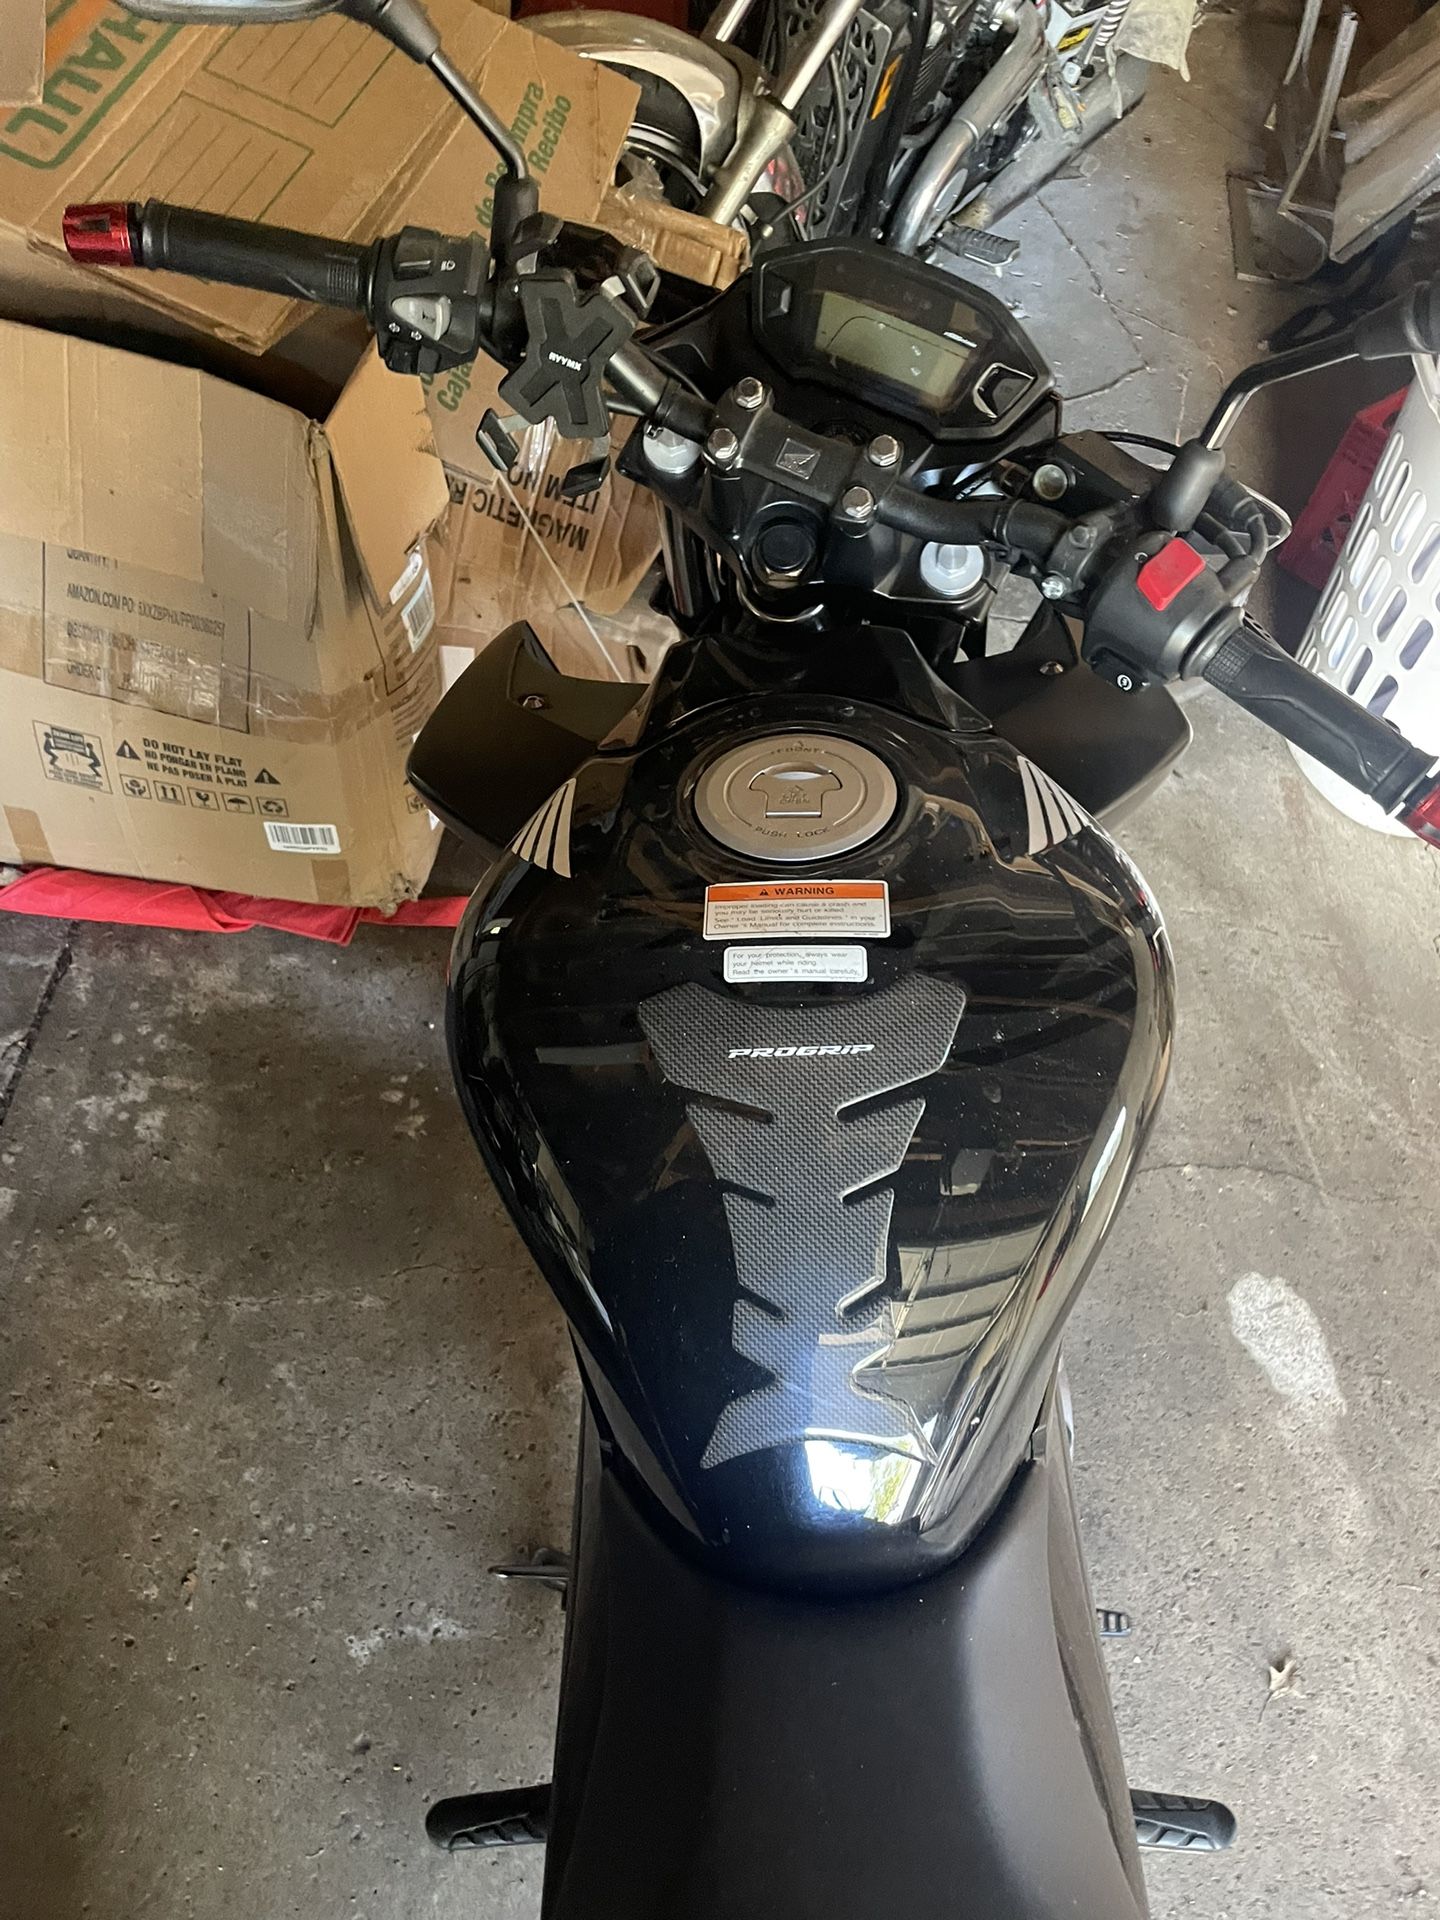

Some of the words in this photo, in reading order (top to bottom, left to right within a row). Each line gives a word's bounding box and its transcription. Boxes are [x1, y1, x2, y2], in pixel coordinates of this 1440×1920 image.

[527, 95, 572, 173] Recibo
[472, 488, 590, 551] MAGNETIC
[142, 737, 159, 749] DO
[162, 742, 185, 756] NOT
[189, 748, 210, 762] LAY
[214, 753, 242, 767] FLAT
[162, 764, 179, 776] PAS
[224, 777, 247, 787] PLAT
[774, 887, 835, 896] WARNING
[728, 1044, 875, 1058] PROGRIP
